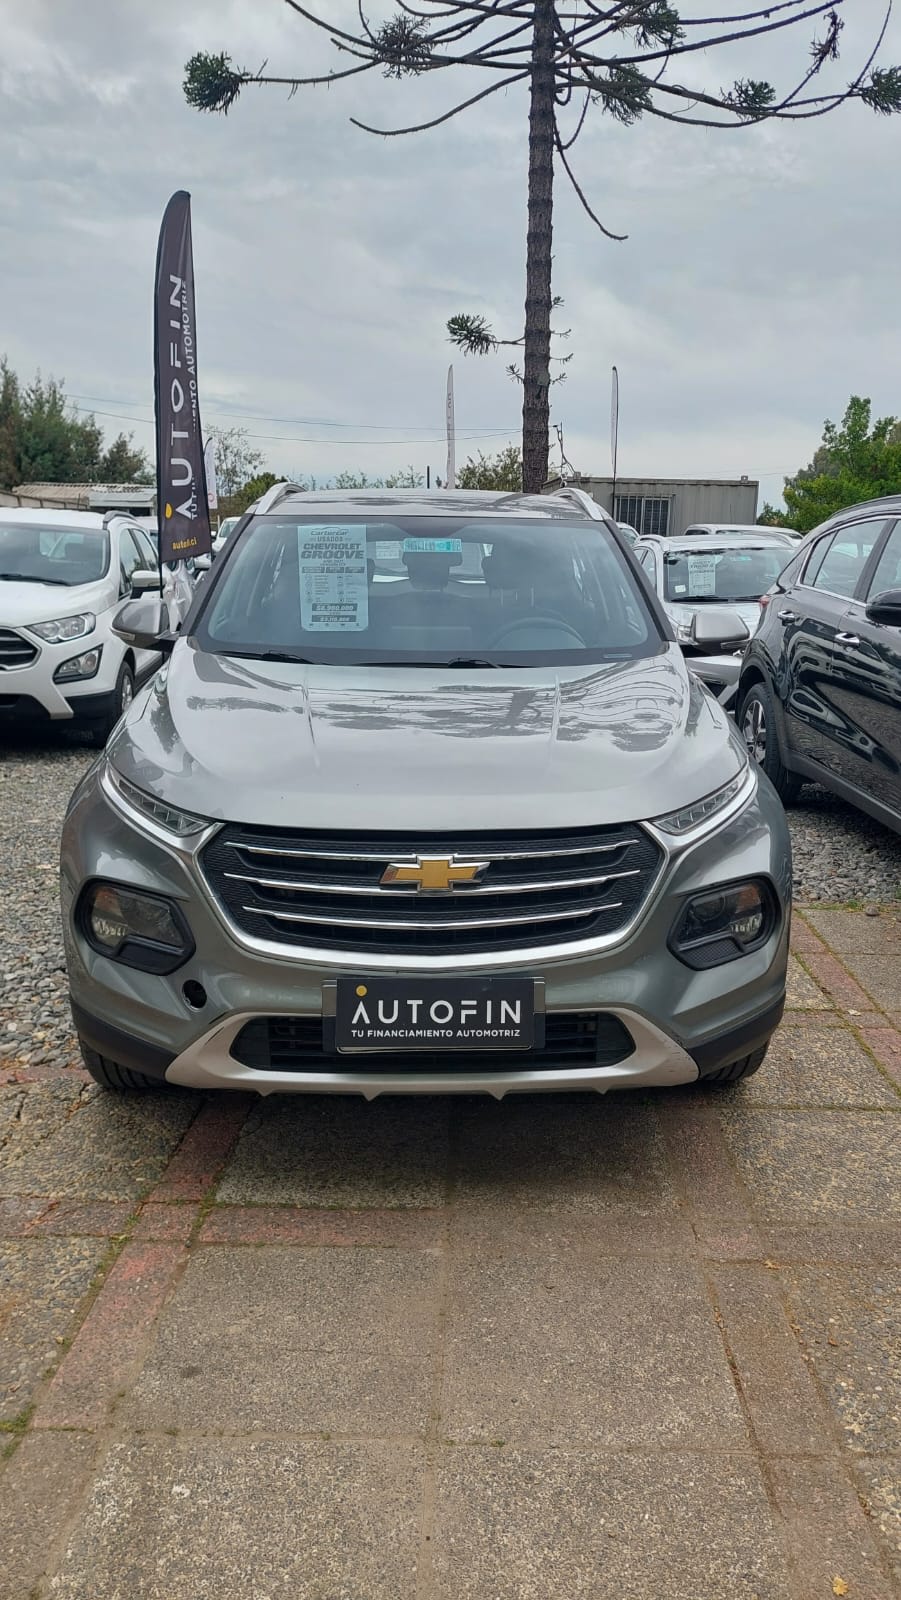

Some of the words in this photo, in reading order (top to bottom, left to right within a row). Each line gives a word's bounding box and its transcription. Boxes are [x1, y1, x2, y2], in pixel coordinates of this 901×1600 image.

[181, 279, 196, 375] AUTOMOTRIZ
[169, 274, 194, 520] AUTOFIN
[301, 550, 365, 559] GROOVE
[303, 542, 362, 550] CHEVROLET
[351, 999, 521, 1024] AUTOFIN
[351, 1030, 365, 1038] TU
[367, 1029, 453, 1038] FINANCIAMIENTO
[456, 1029, 521, 1037] AUTOMOTRIZ
